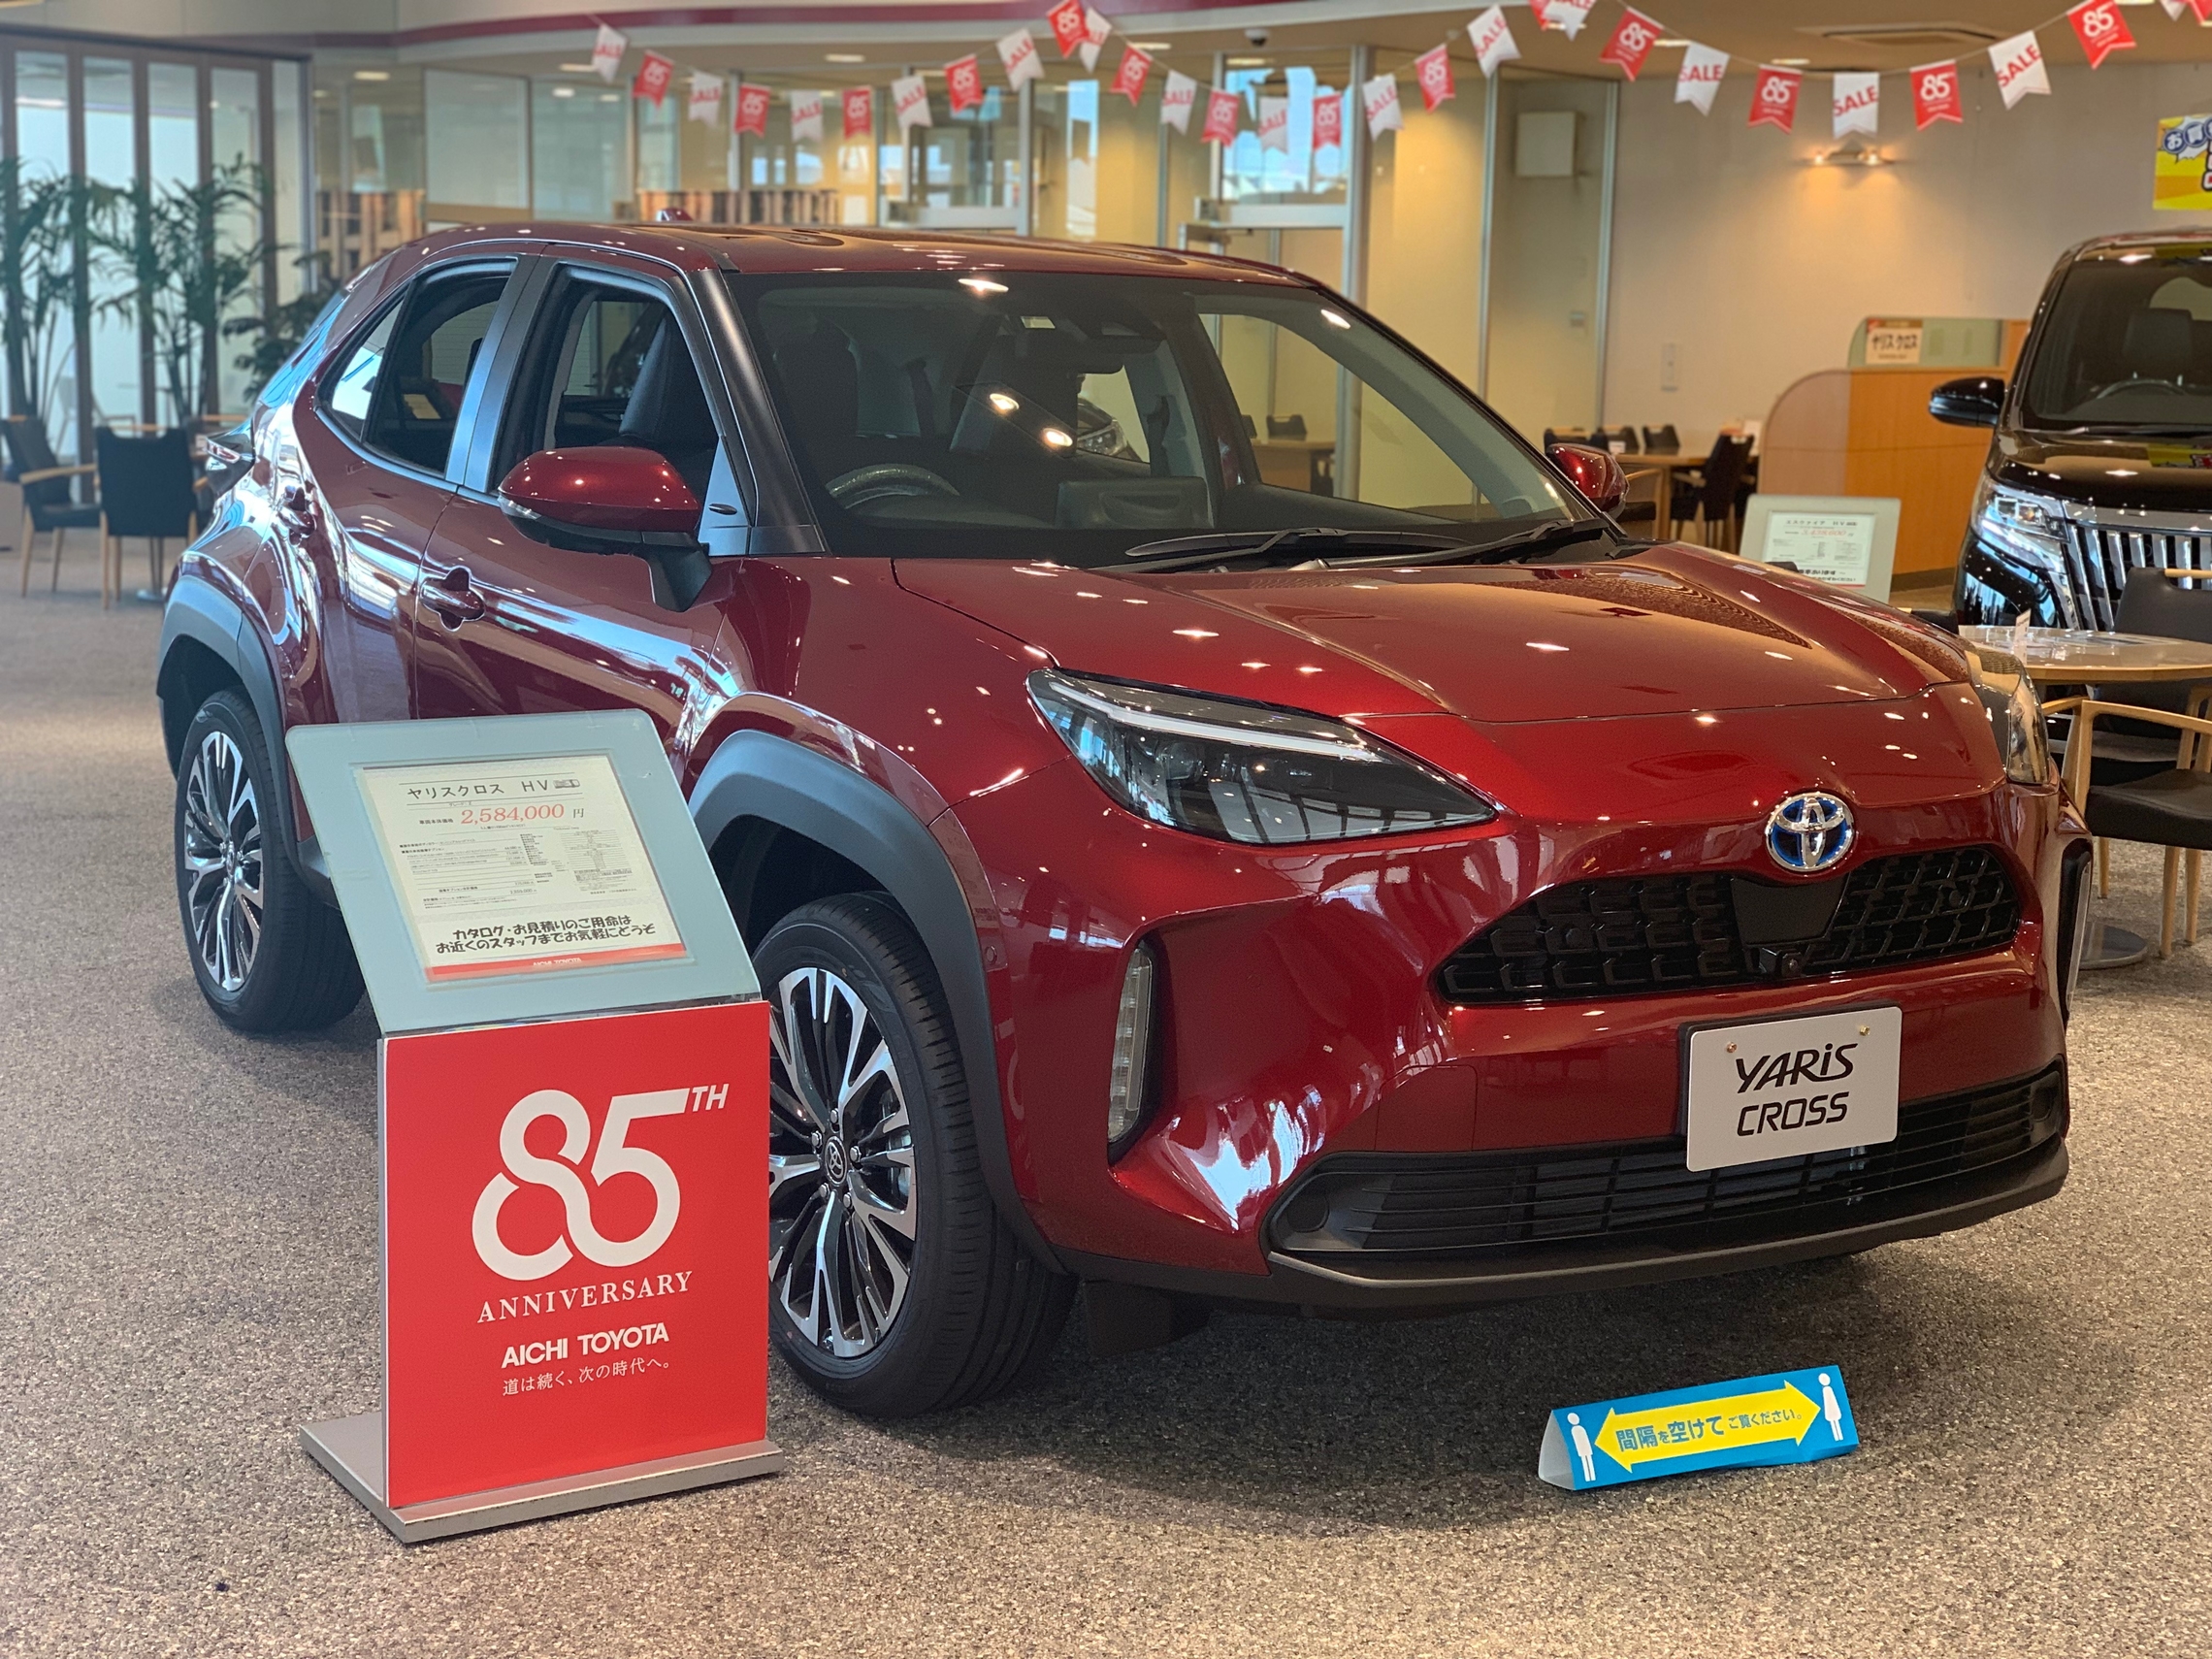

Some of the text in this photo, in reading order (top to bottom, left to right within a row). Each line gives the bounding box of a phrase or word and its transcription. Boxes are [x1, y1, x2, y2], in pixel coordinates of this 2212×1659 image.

[1057, 4, 1081, 35] 85
[2083, 1, 2115, 37] 85
[1476, 16, 1507, 59] SALE
[1619, 21, 1656, 52] 85
[1124, 54, 1151, 81] 85
[1423, 56, 1448, 86] 85
[1678, 64, 1723, 82] SALE
[1996, 45, 2042, 88] SALE
[1761, 76, 1800, 104] 85
[1833, 84, 1878, 117] SALE
[1920, 72, 1955, 102] 85
[1367, 84, 1397, 122] SALE
[407, 779, 548, 799] ヤリスクロス HV
[461, 803, 565, 825] 2,584,000
[573, 807, 584, 819] 円
[437, 923, 656, 954] お近くのスタッフまでお気軽にどうぞ
[453, 915, 632, 940] カタログ・お見積りのご用命は
[1737, 1091, 1849, 1136] CROSS
[477, 1271, 693, 1323] ANNIVERSARY
[501, 1322, 669, 1369] AICHI TOYOTA
[503, 1356, 669, 1396] 道は続く、次の時代へ。
[1615, 1409, 1803, 1452] 間隔を空けて ご覧ください。
